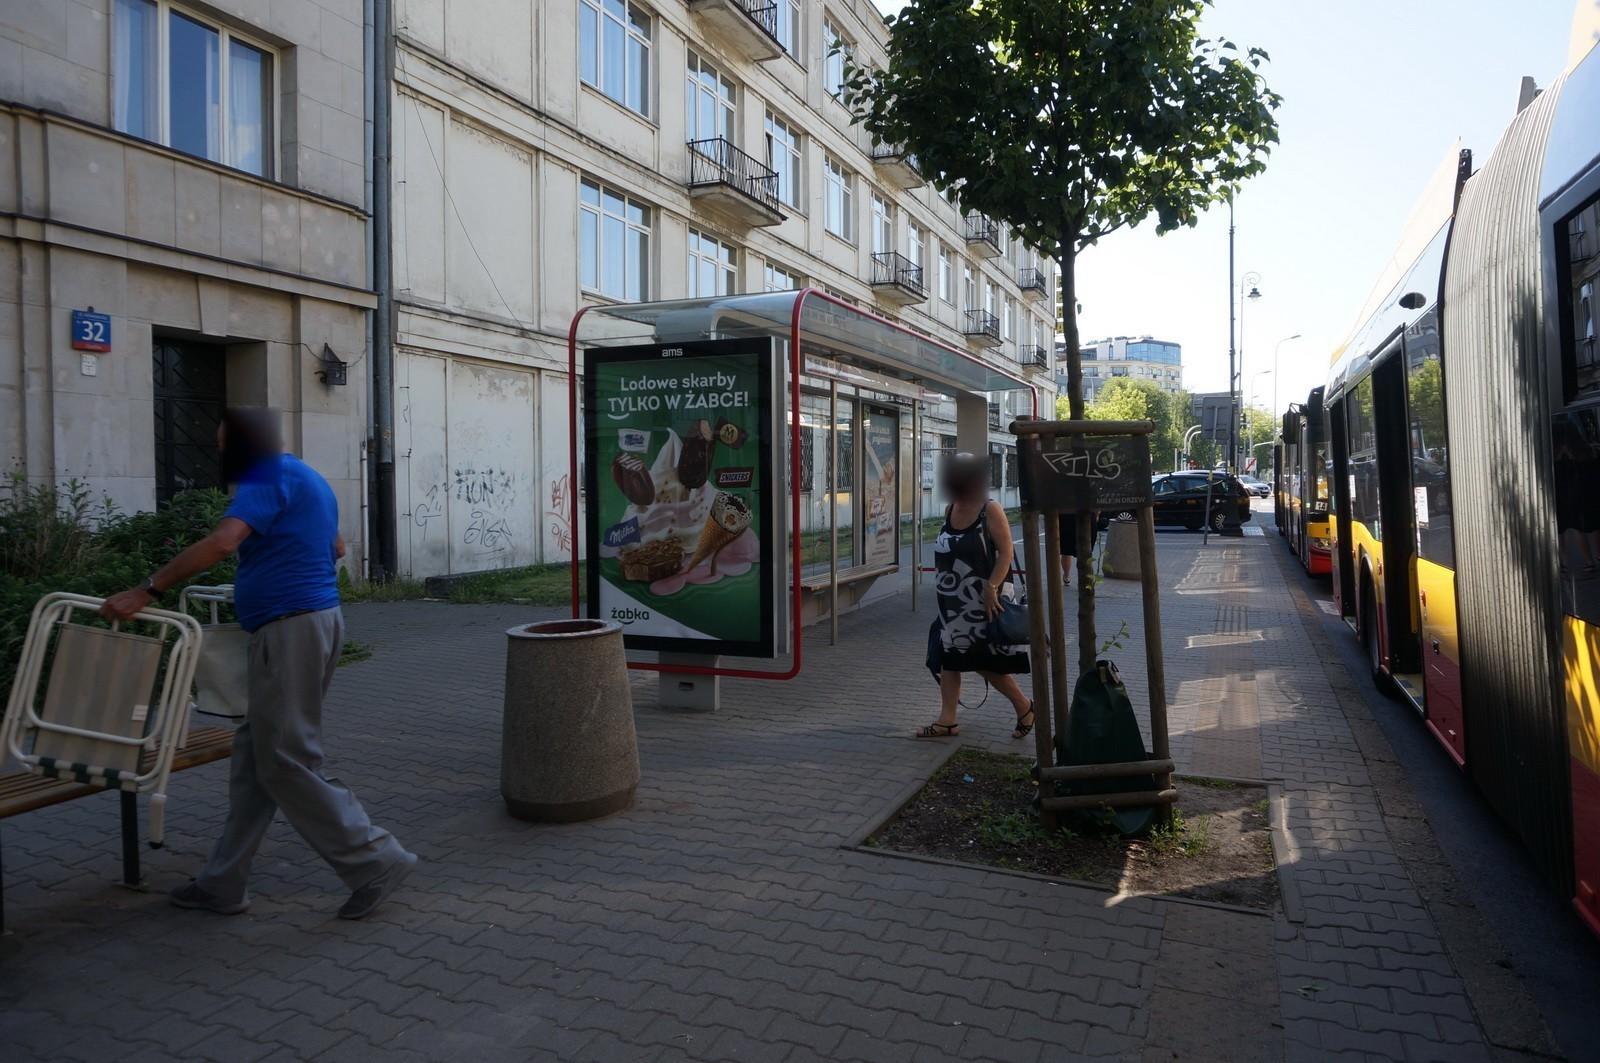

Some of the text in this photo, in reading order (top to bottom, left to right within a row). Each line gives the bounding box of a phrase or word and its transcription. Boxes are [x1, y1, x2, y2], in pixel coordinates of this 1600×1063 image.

[81, 320, 105, 342] 32
[661, 347, 684, 357] ams
[620, 370, 737, 392] Lodowe skarby
[607, 389, 750, 412] TYLKO W ŻABCE!
[720, 472, 750, 482] SNICKERS
[609, 523, 636, 545] Milka
[610, 607, 650, 621] żabka
